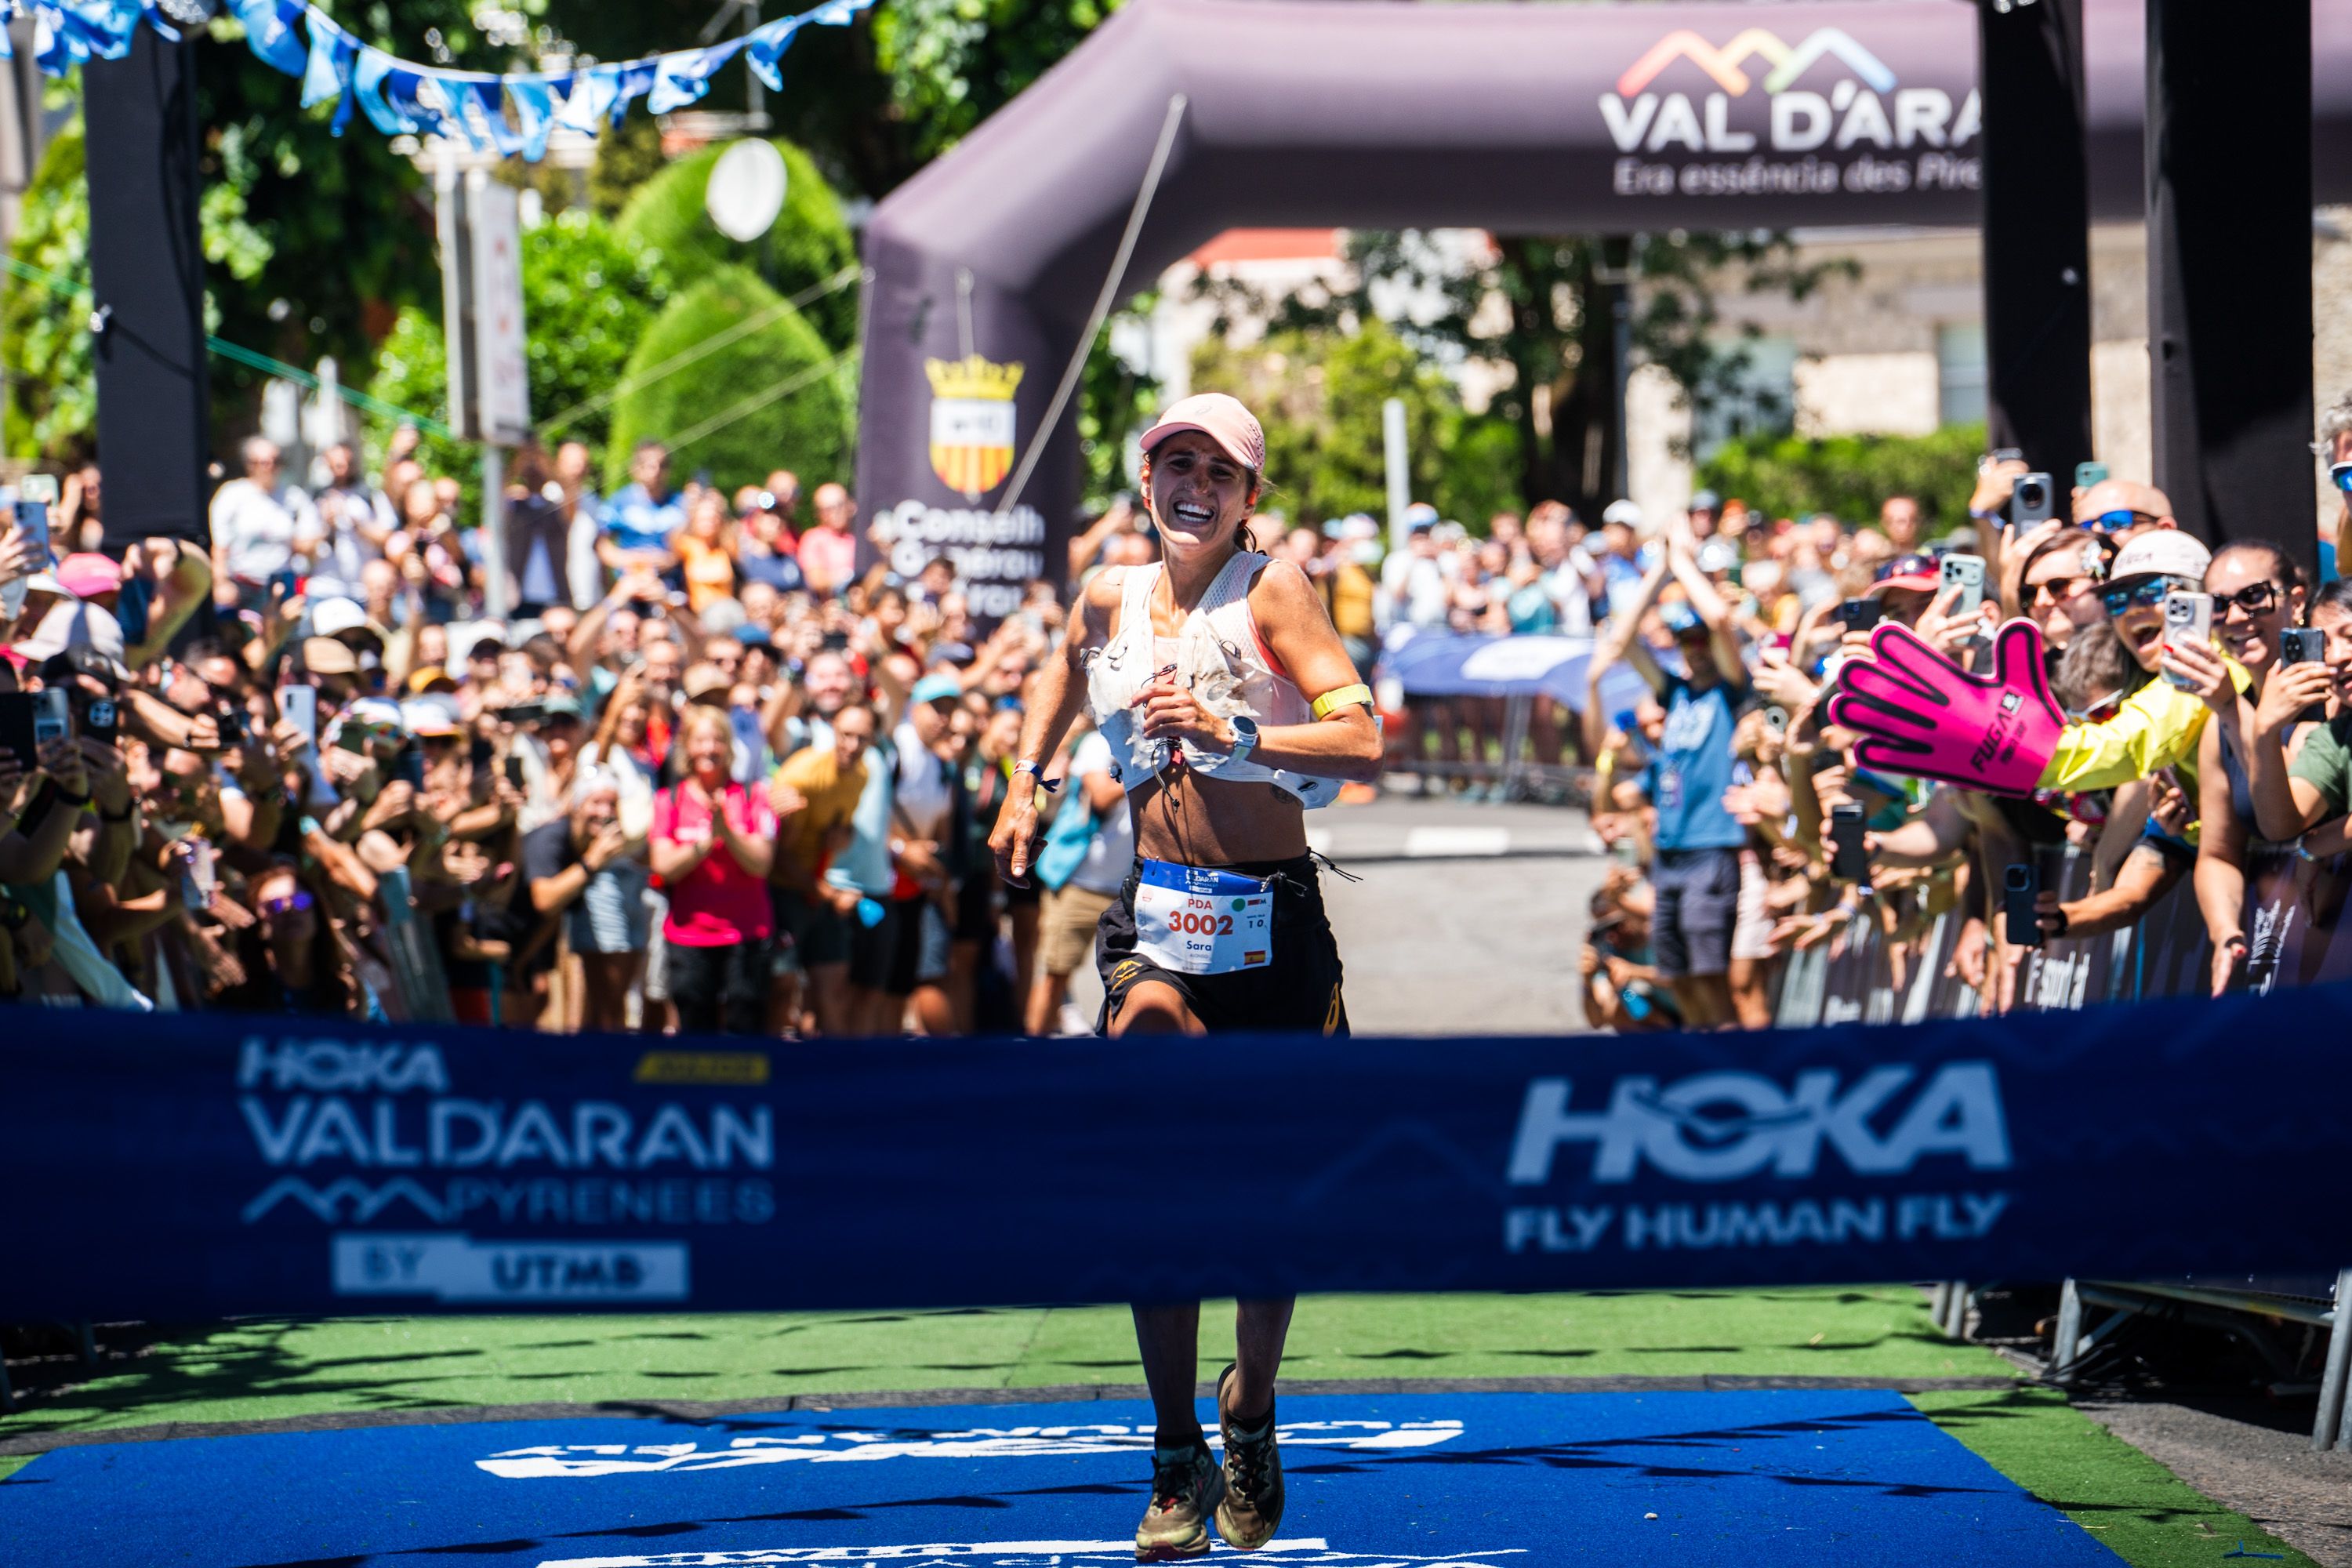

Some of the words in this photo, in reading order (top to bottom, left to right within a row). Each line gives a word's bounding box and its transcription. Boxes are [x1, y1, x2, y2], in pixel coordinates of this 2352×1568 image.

[1599, 92, 1756, 152] VAL
[1615, 157, 1674, 194] Era
[1844, 152, 1911, 192] des
[892, 499, 1045, 545] Conselh
[1169, 911, 1233, 936] 3002
[1188, 899, 1213, 909] PDA
[1186, 941, 1211, 951] Sara
[240, 1038, 449, 1091] HOKA
[1507, 1060, 2009, 1185] HOKA
[1507, 1206, 1612, 1251] FLY
[1624, 1197, 1883, 1248] HUMAN
[1895, 1190, 2009, 1242] FLY
[360, 1243, 425, 1282] BY
[492, 1252, 647, 1291] UTMB
